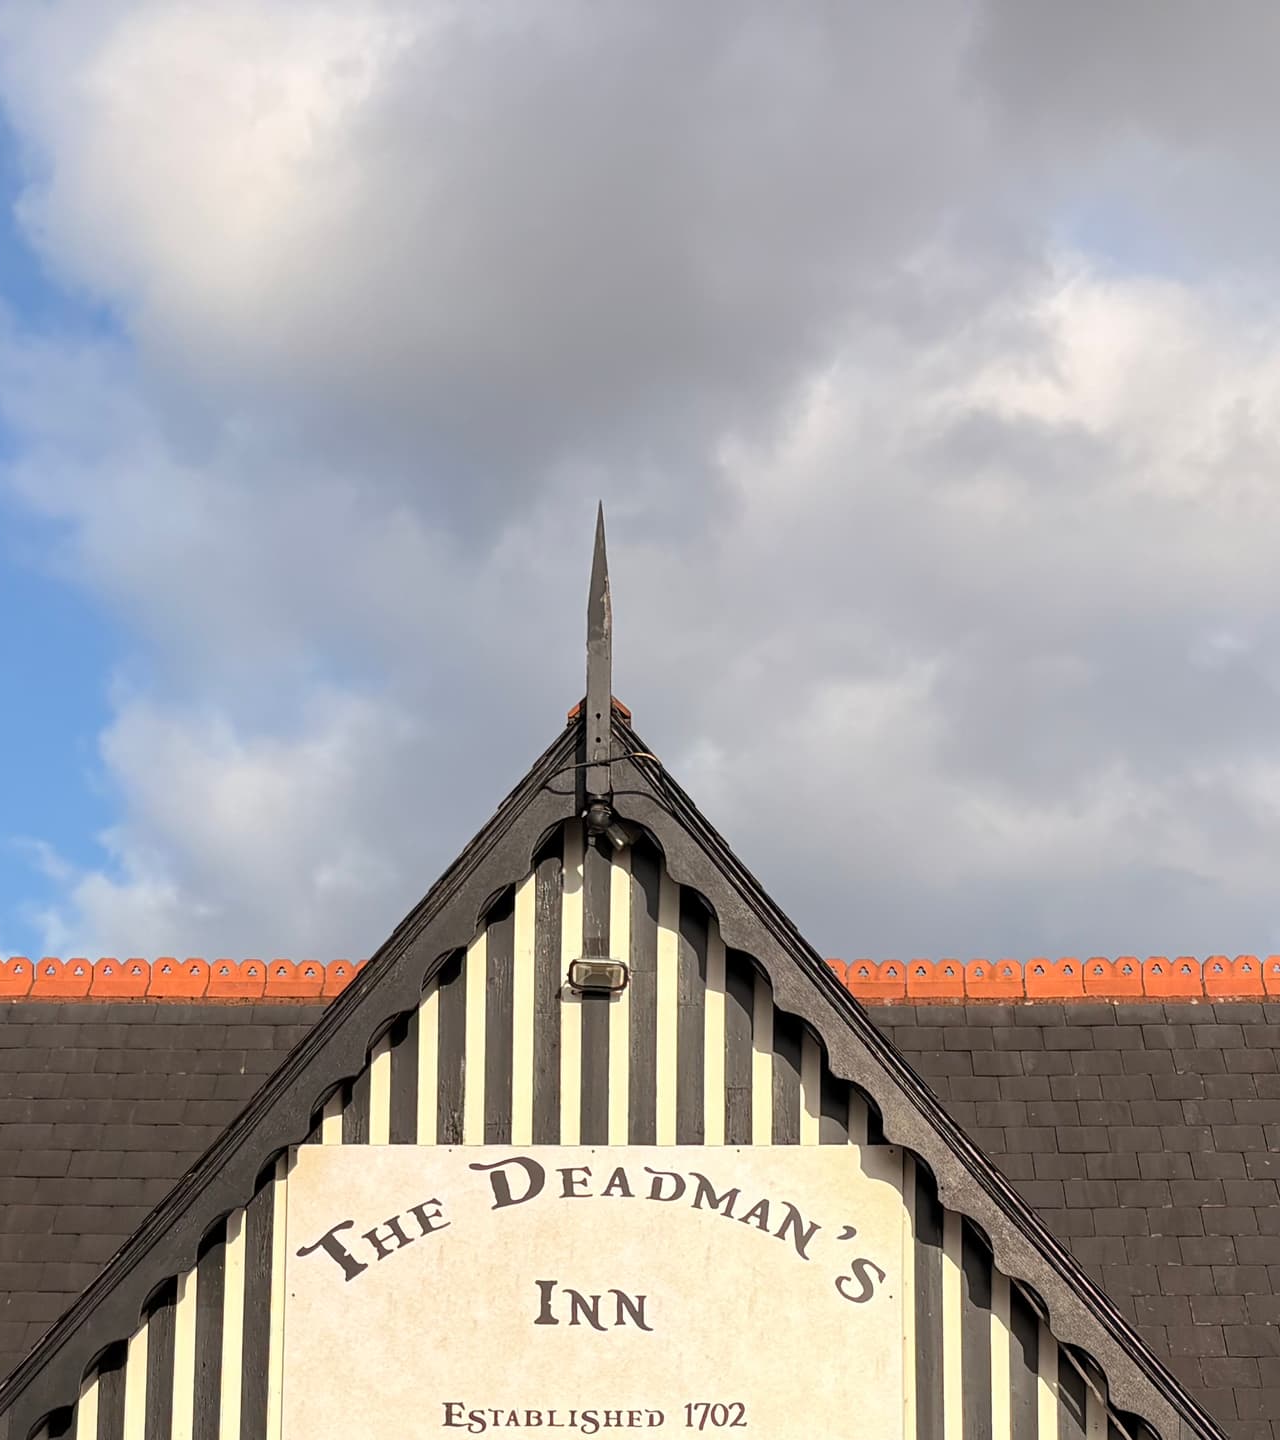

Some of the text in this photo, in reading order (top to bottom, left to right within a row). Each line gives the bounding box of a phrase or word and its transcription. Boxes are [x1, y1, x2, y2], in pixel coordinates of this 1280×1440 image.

[296, 1156, 887, 1304] THE DEADMAN'S
[534, 1280, 653, 1331] INN
[443, 1402, 747, 1434] ESTABLISHED 1702
